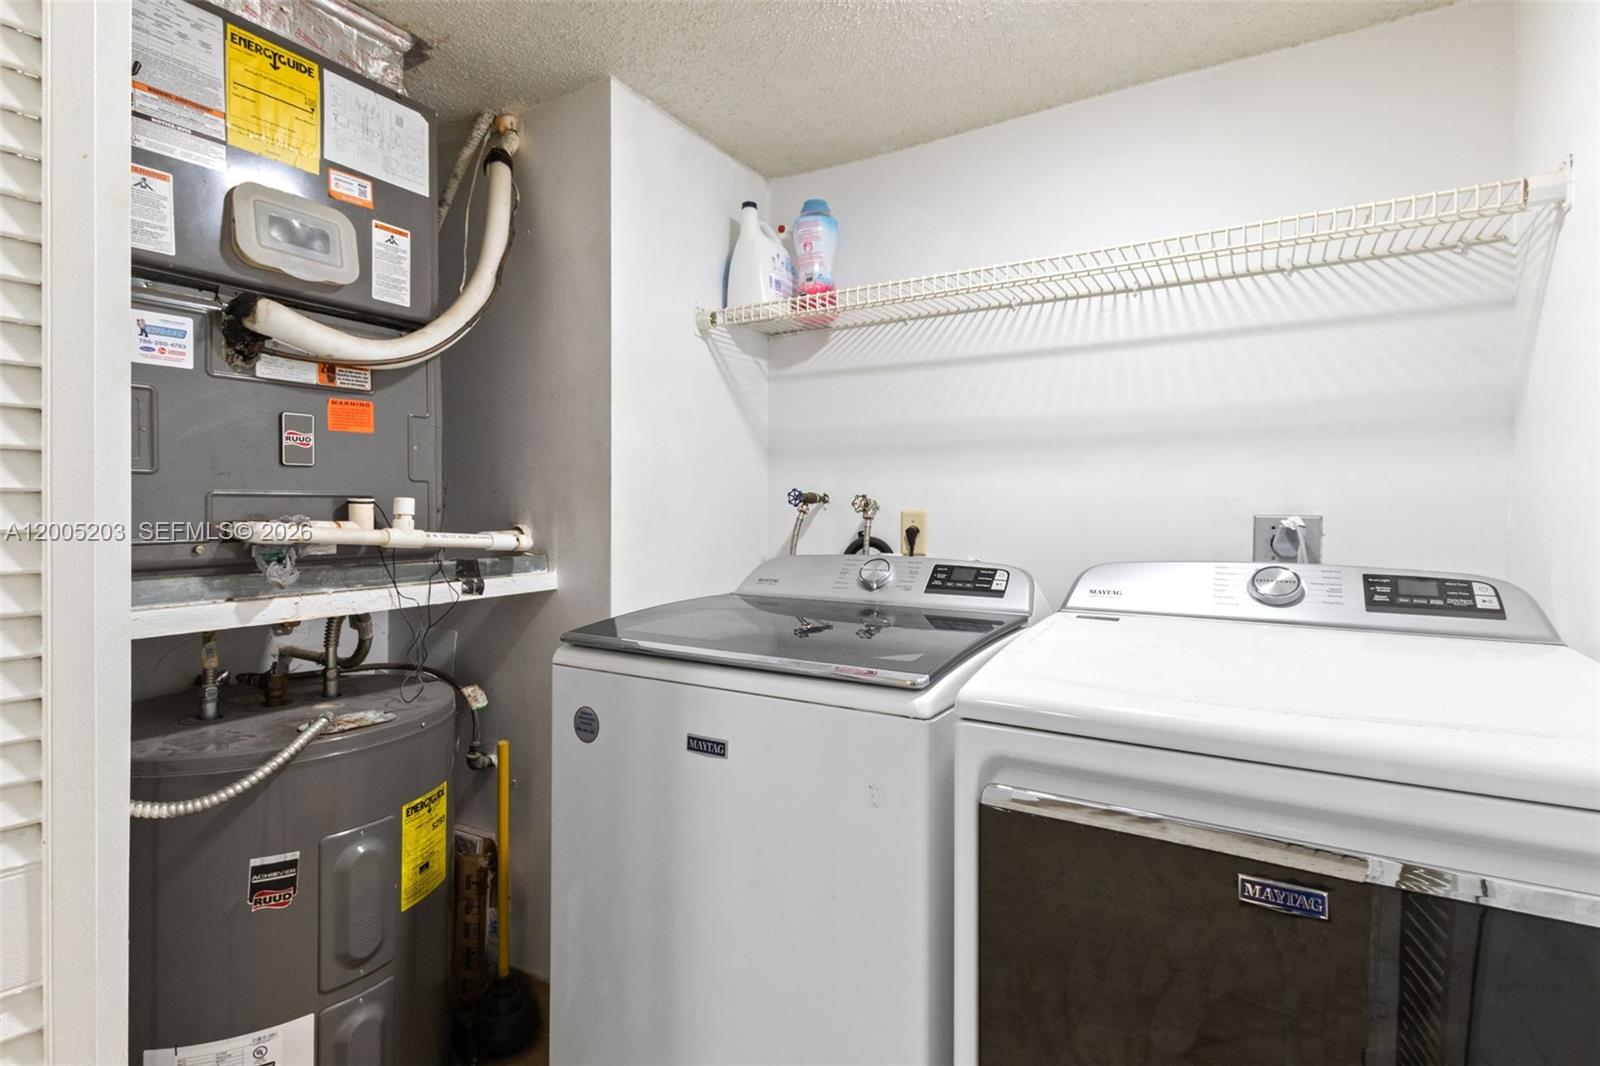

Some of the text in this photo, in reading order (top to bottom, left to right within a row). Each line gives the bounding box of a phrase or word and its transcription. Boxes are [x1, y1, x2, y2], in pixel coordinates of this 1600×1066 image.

[230, 31, 315, 79] ENERGYGUIDE
[330, 399, 371, 408] WARNING
[285, 435, 312, 443] RUUD
[688, 738, 725, 754] MAYTAG
[252, 868, 297, 881] ACHIEVER
[253, 892, 292, 906] RUUD
[1243, 882, 1323, 913] MAYTAG
